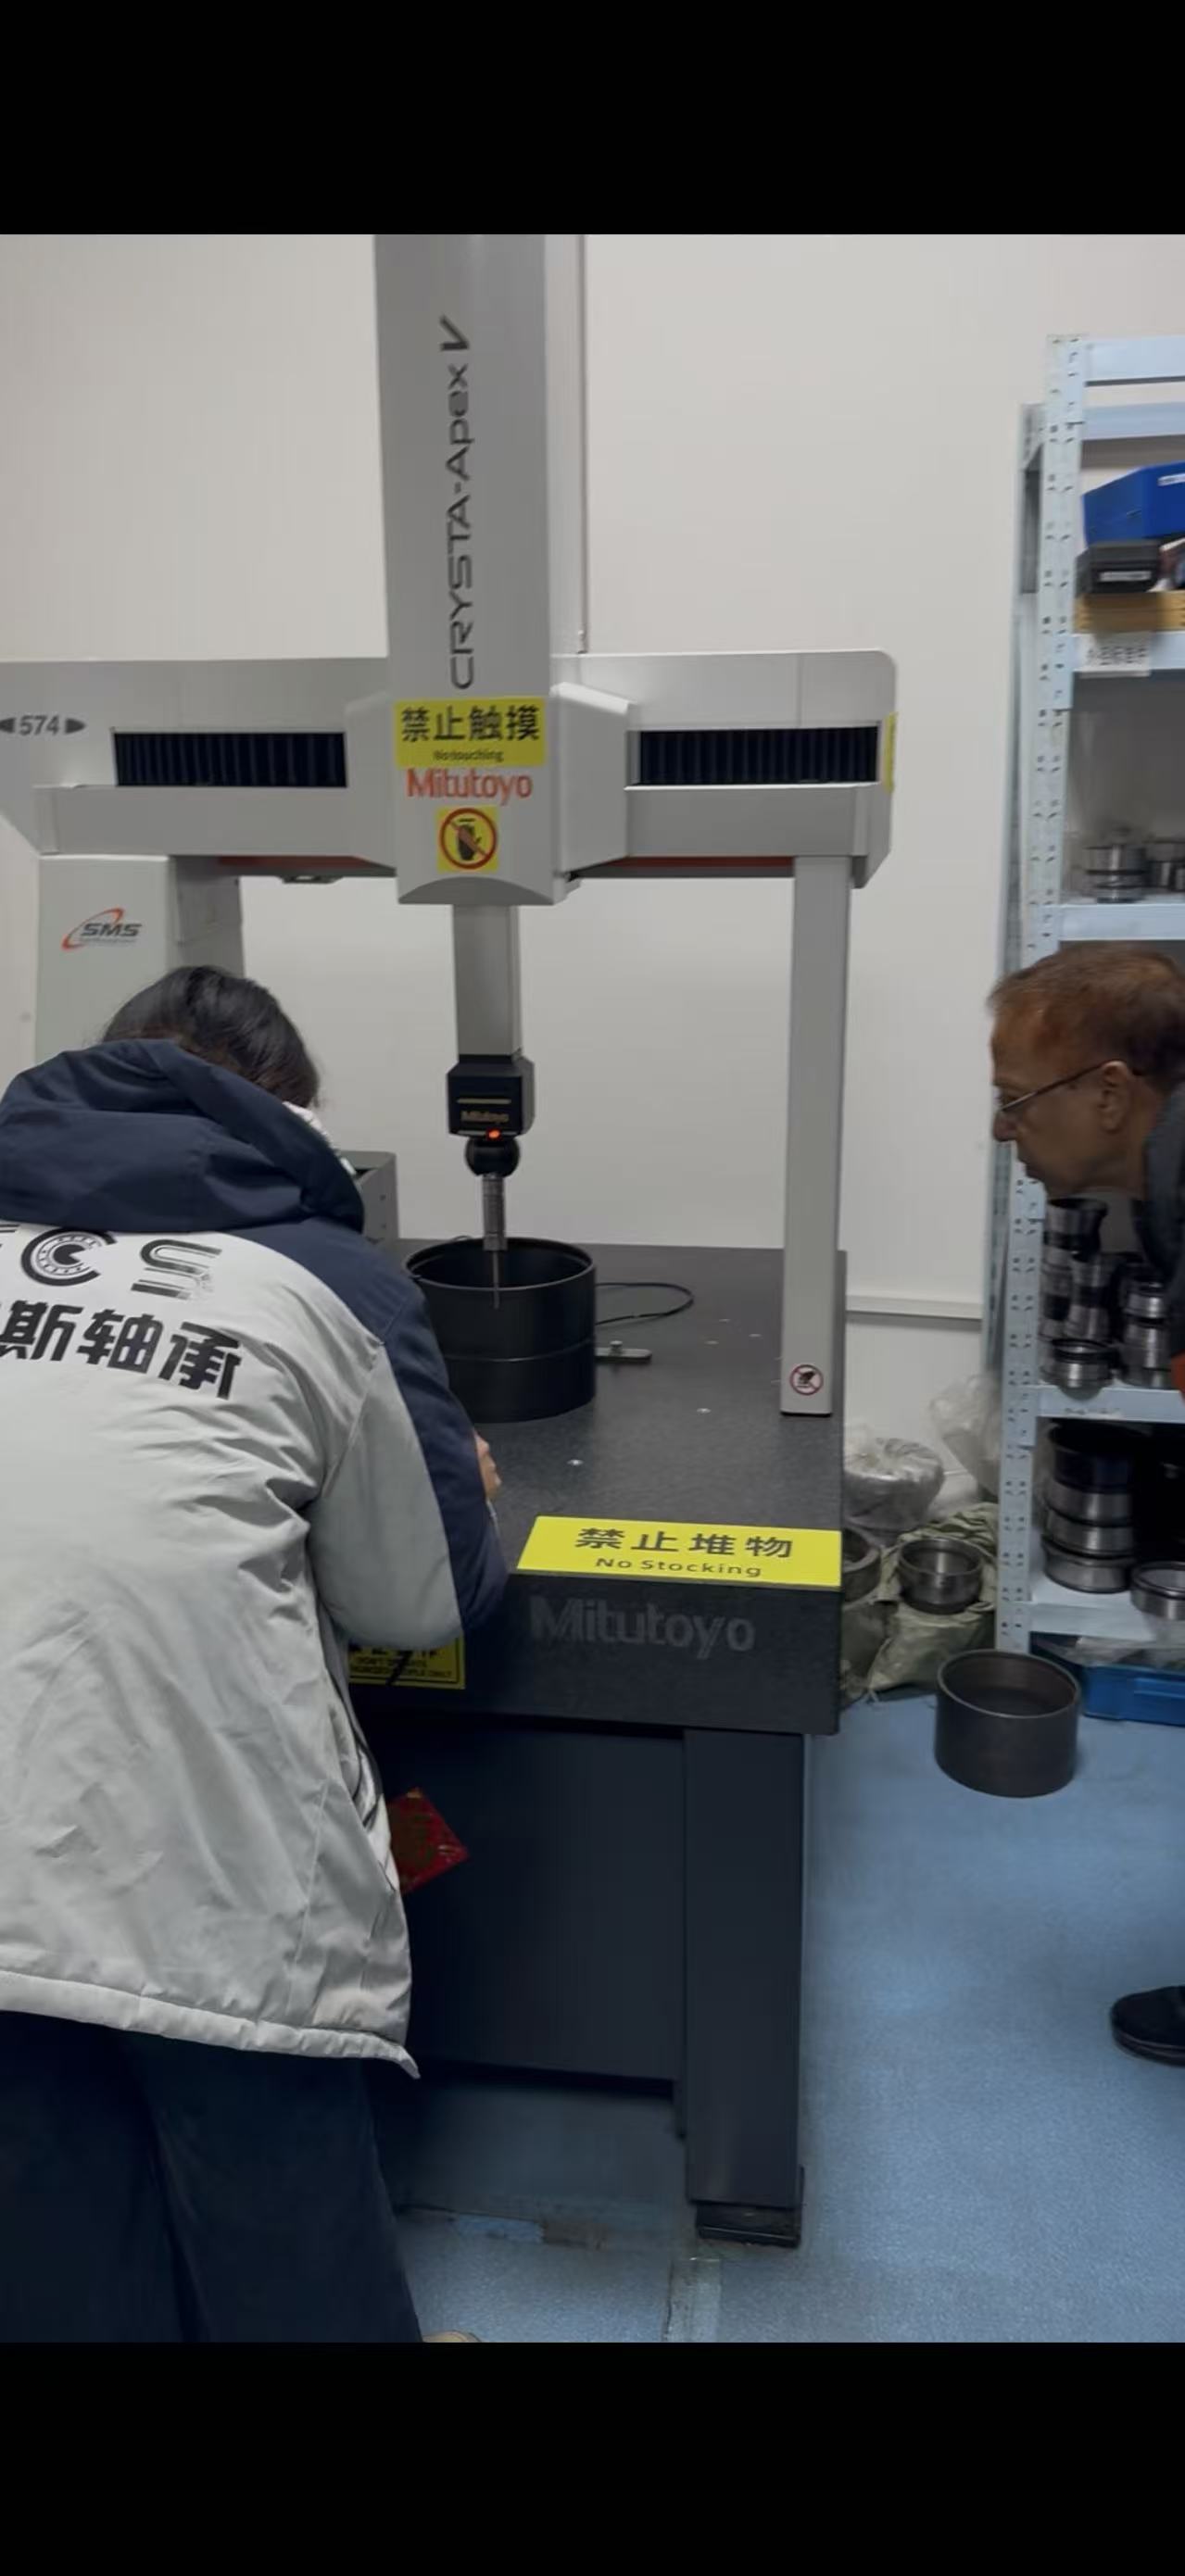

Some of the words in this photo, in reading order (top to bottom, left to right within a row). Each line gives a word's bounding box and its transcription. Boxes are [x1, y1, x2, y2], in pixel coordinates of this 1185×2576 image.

[438, 314, 471, 352] V
[445, 362, 475, 690] CRYSTA-Apex
[19, 715, 59, 736] 574
[402, 705, 540, 742] 禁止触摸
[406, 767, 533, 806] Mitutoyo
[81, 922, 143, 936] SMS
[575, 1527, 792, 1558] 禁止堆物
[595, 1557, 632, 1568] No
[640, 1559, 762, 1577] Stocking
[529, 1595, 756, 1659] Mitutoyo
